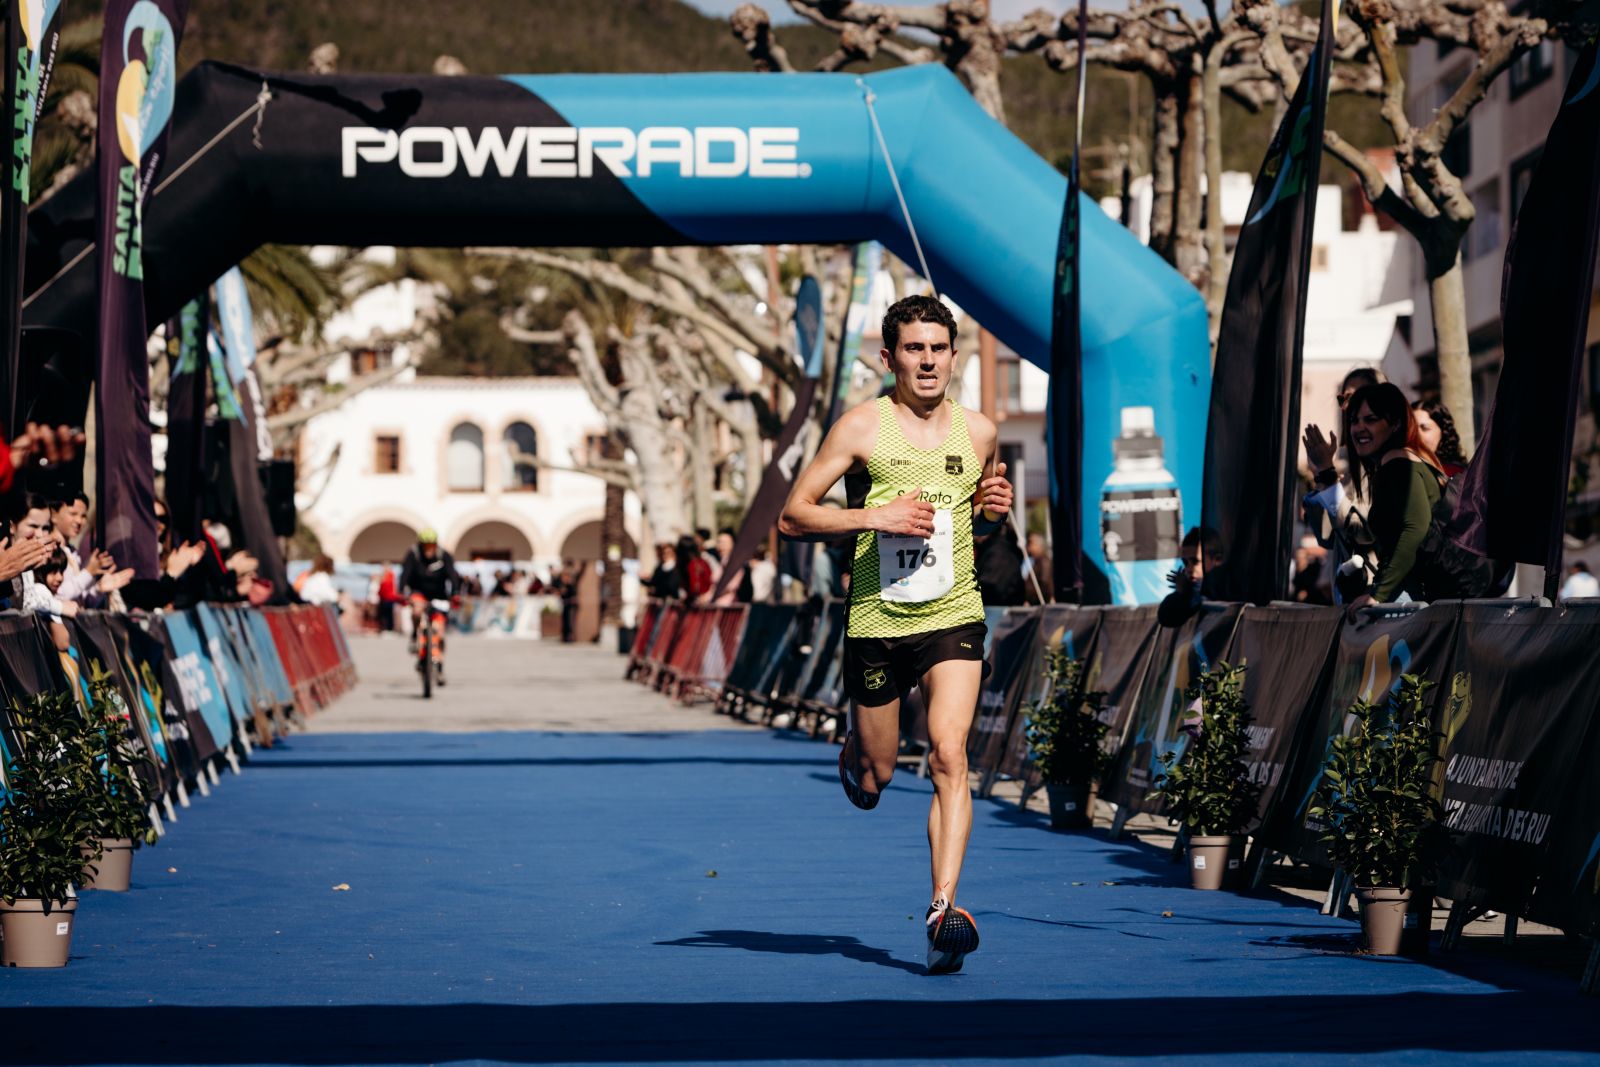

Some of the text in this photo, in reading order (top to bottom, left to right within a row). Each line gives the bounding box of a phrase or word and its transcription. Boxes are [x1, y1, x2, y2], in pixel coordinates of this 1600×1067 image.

[341, 126, 800, 178] POWERADE
[113, 165, 136, 275] SANTA
[919, 490, 952, 505] Rota
[896, 544, 937, 569] 176
[1523, 811, 1551, 845] RIU
